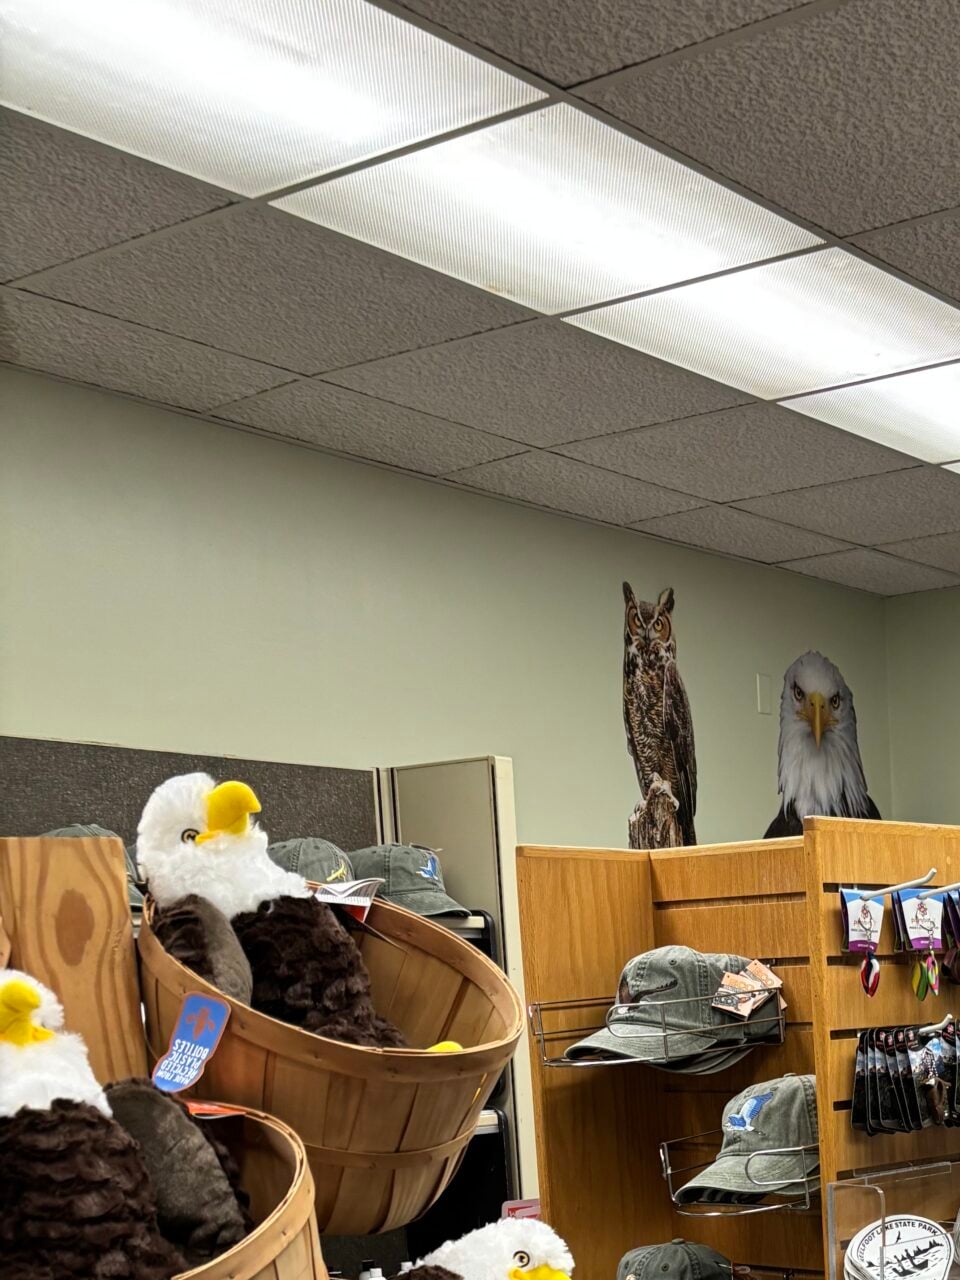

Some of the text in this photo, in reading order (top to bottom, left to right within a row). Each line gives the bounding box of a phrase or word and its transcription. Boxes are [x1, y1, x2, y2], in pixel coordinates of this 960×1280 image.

[173, 1038, 209, 1059] BOTTLES
[160, 1059, 198, 1080] RECYCLED
[168, 1051, 202, 1070] PLASTIC
[894, 1220, 916, 1229] STATE
[918, 1222, 939, 1237] PARK
